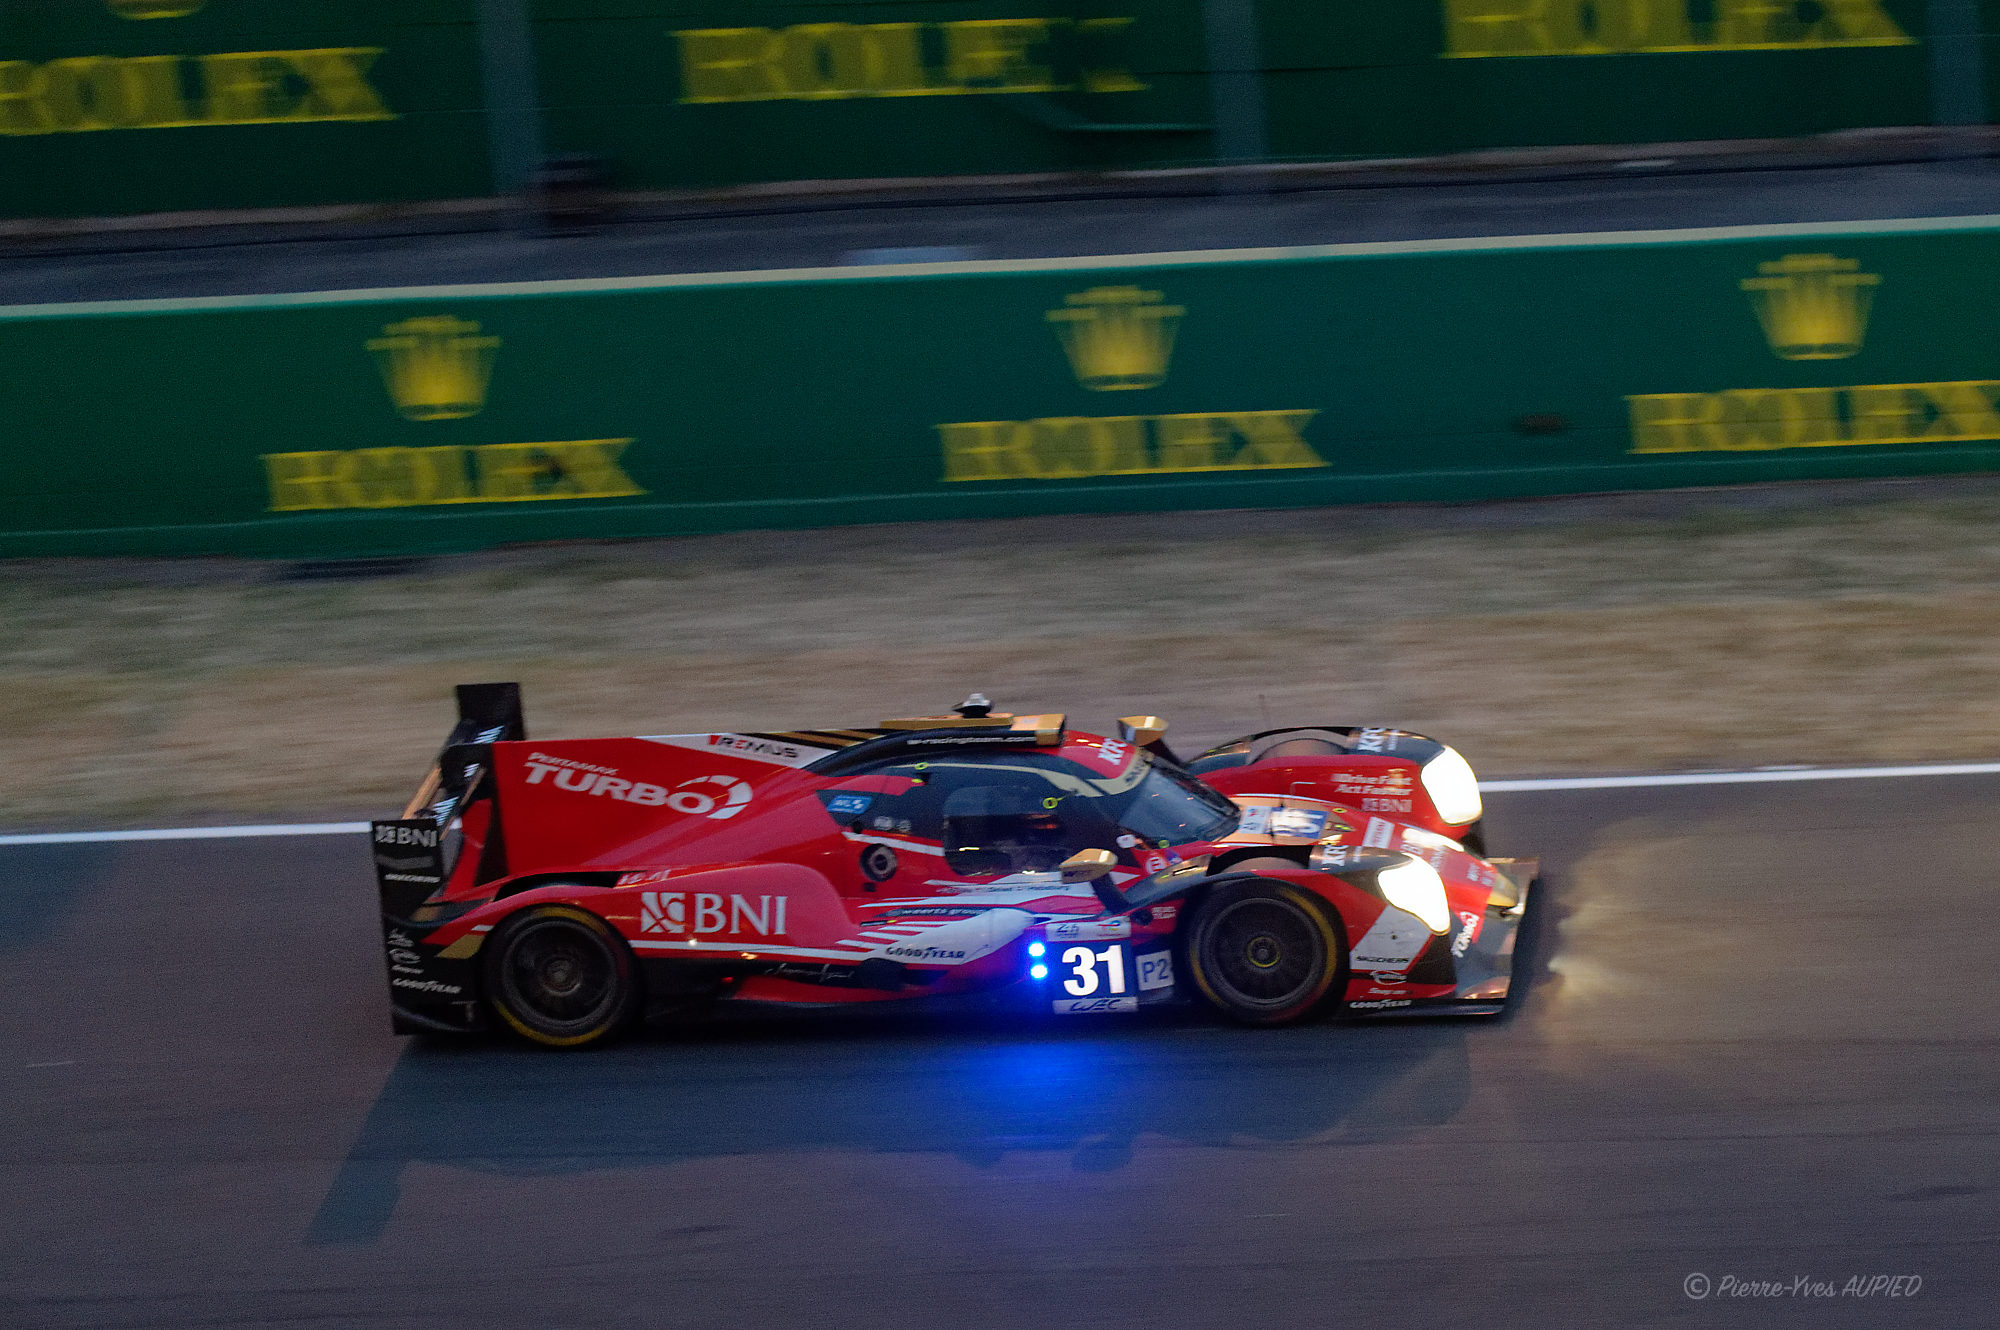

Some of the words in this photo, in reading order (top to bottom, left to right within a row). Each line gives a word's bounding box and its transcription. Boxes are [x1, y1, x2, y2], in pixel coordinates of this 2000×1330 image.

[1438, 0, 1920, 59] ROLEX
[0, 47, 399, 136] OLEX
[932, 409, 1333, 484] ROLEX
[257, 438, 652, 513] ROLEX
[719, 736, 799, 758] REMUS
[1097, 738, 1128, 766] KFC
[523, 761, 715, 815] TURBO
[396, 826, 438, 848] BNI
[694, 893, 789, 936] BNI
[885, 946, 966, 960] GOODYEAR
[1062, 944, 1126, 996] 31
[1142, 958, 1169, 983] P2
[1070, 999, 1121, 1012] WEC
